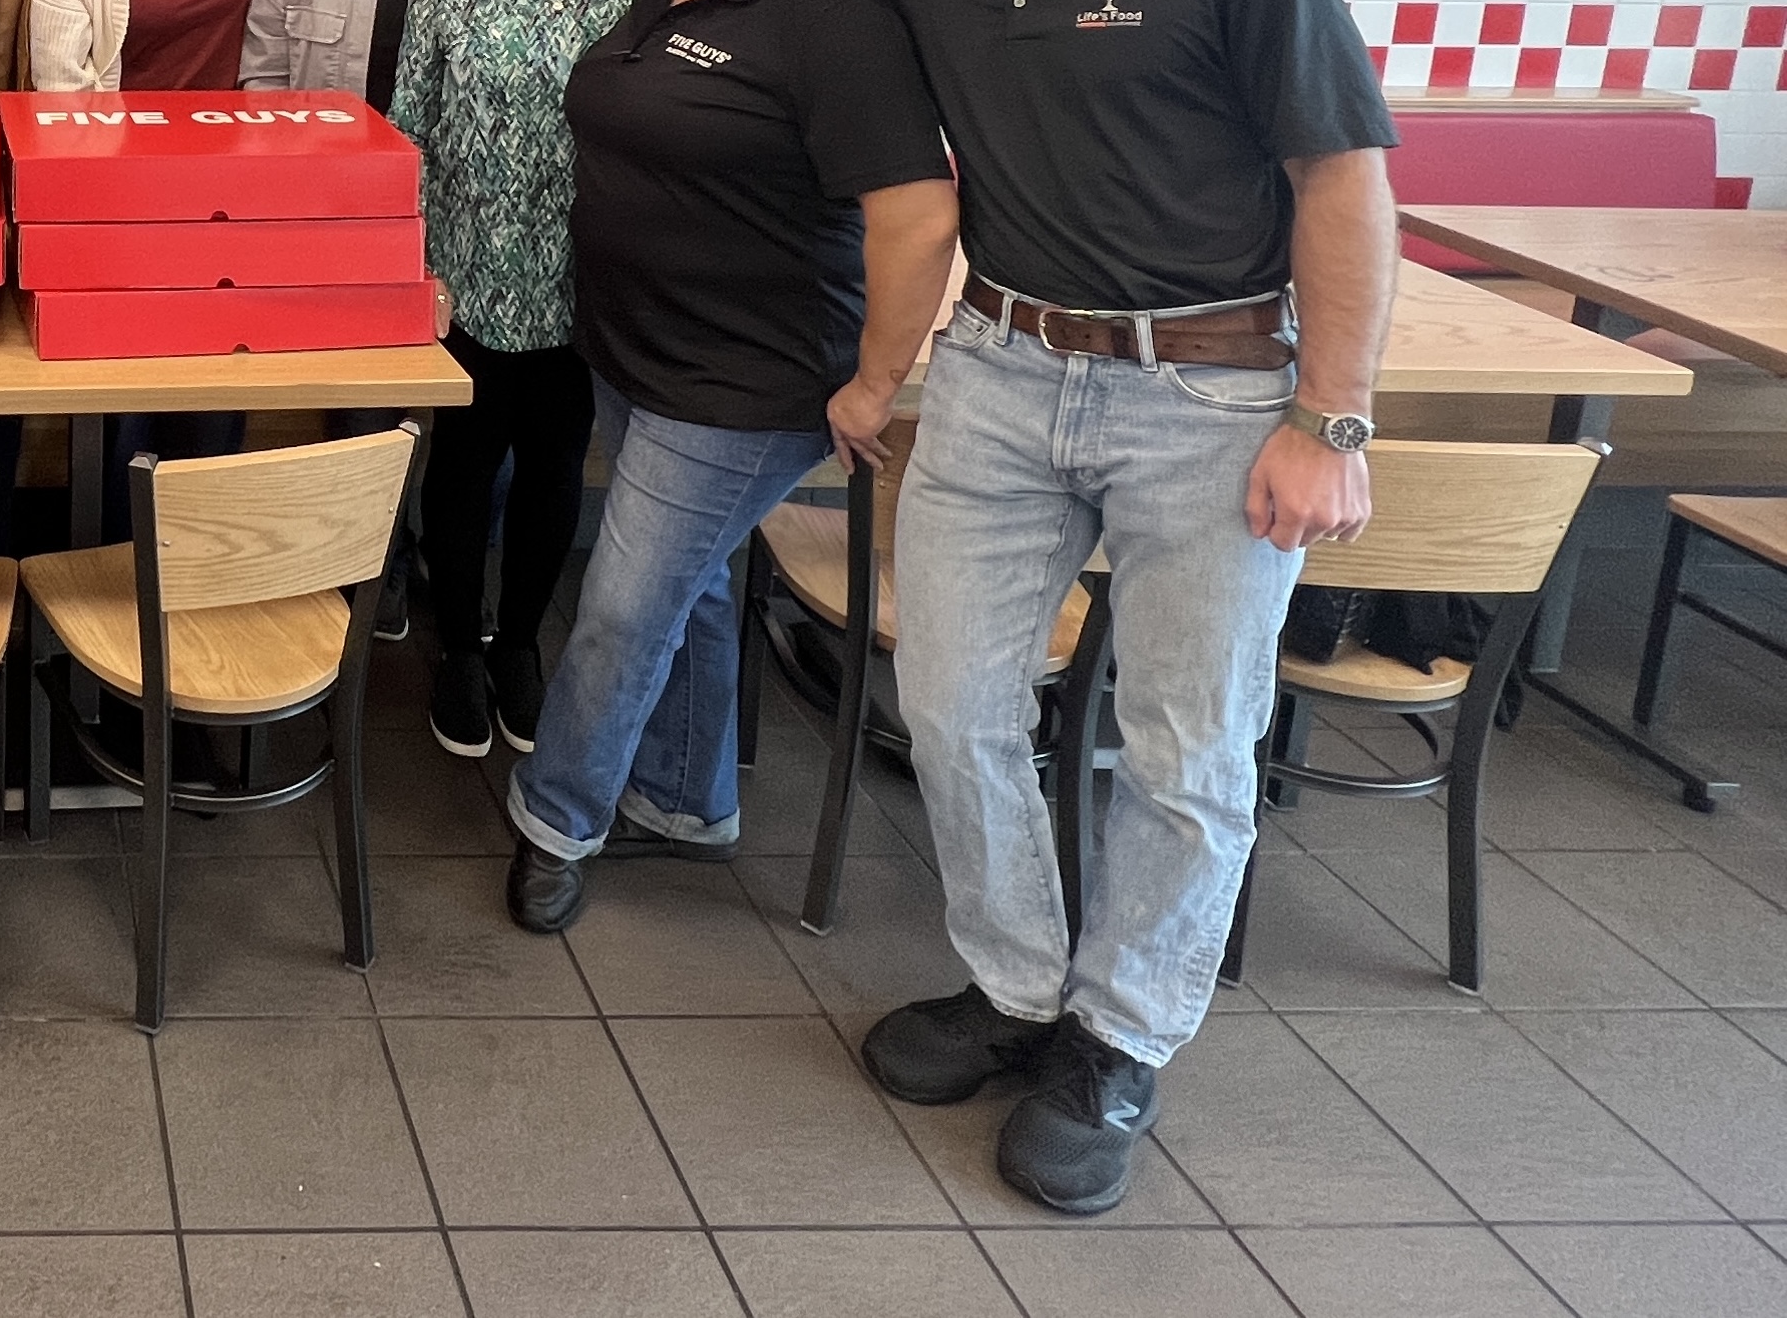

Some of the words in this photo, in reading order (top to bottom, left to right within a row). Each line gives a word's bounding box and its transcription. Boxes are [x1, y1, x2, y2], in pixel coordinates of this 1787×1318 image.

[668, 33, 695, 50] FIVE
[35, 111, 170, 125] FIVE
[190, 110, 356, 124] GUYS
